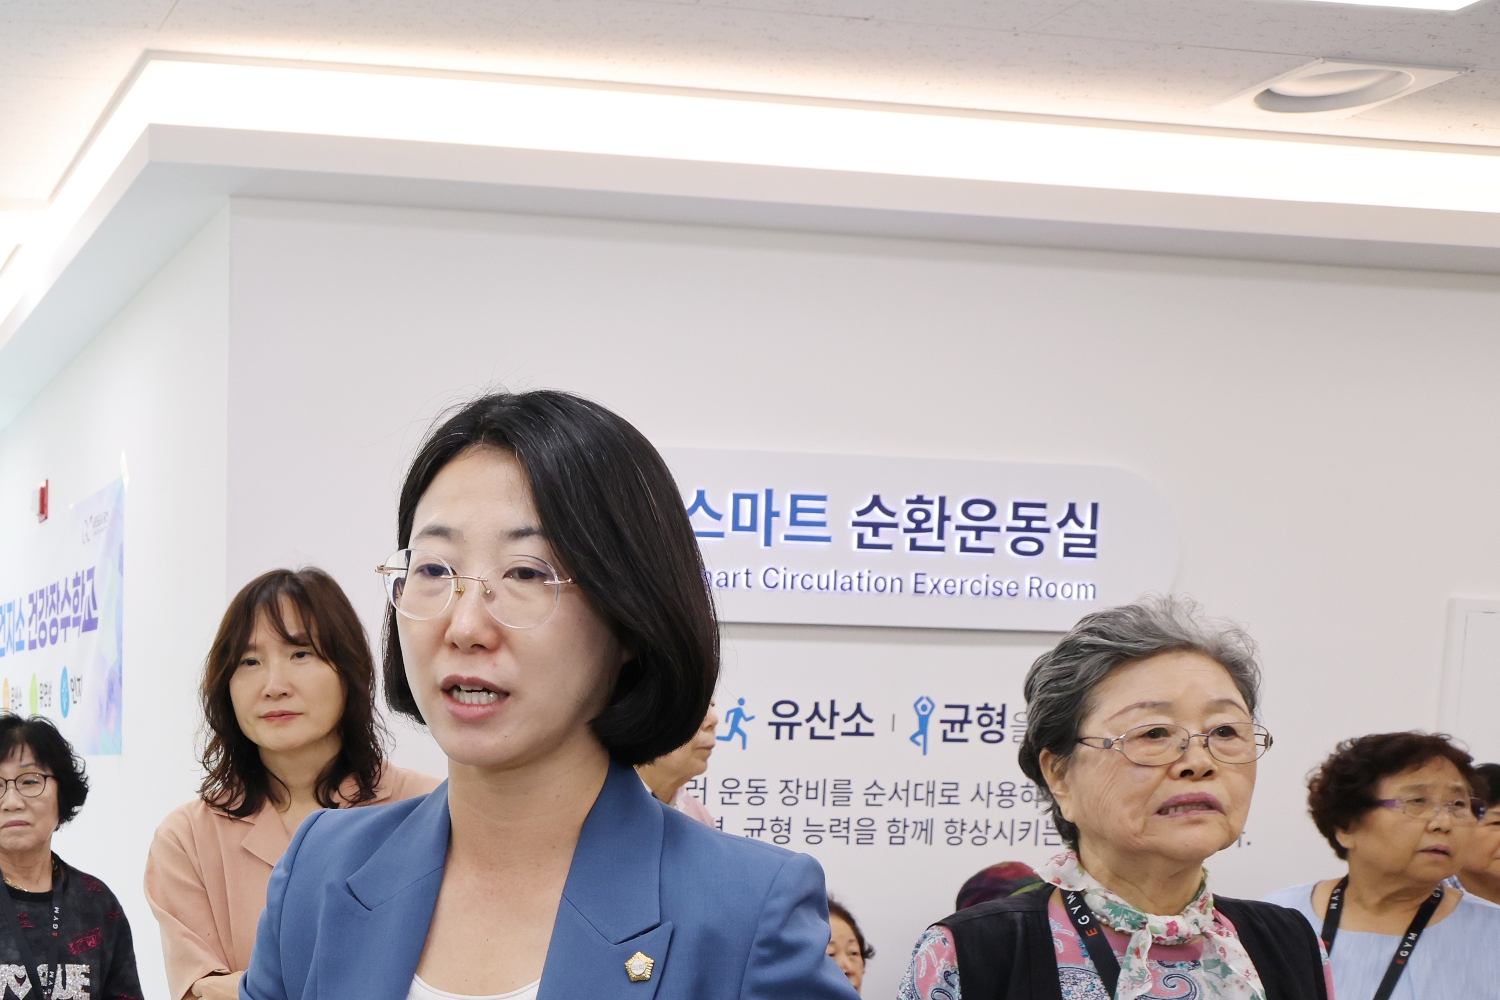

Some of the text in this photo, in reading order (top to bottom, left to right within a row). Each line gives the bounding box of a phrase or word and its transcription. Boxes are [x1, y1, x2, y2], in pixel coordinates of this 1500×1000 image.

[687, 488, 1099, 559] 스마트 순환운동실
[703, 567, 1096, 600] art Circulation Exercise Room
[28, 565, 99, 651] 건강장수학교
[70, 674, 82, 704] 인지
[768, 699, 875, 741] 유산소
[686, 777, 1040, 809] 러 운동 장비를 순서대로 사용하
[743, 816, 792, 845] 균형
[802, 817, 877, 846] 능력을
[886, 817, 935, 846] 함께
[1065, 891, 1099, 938] EGYM
